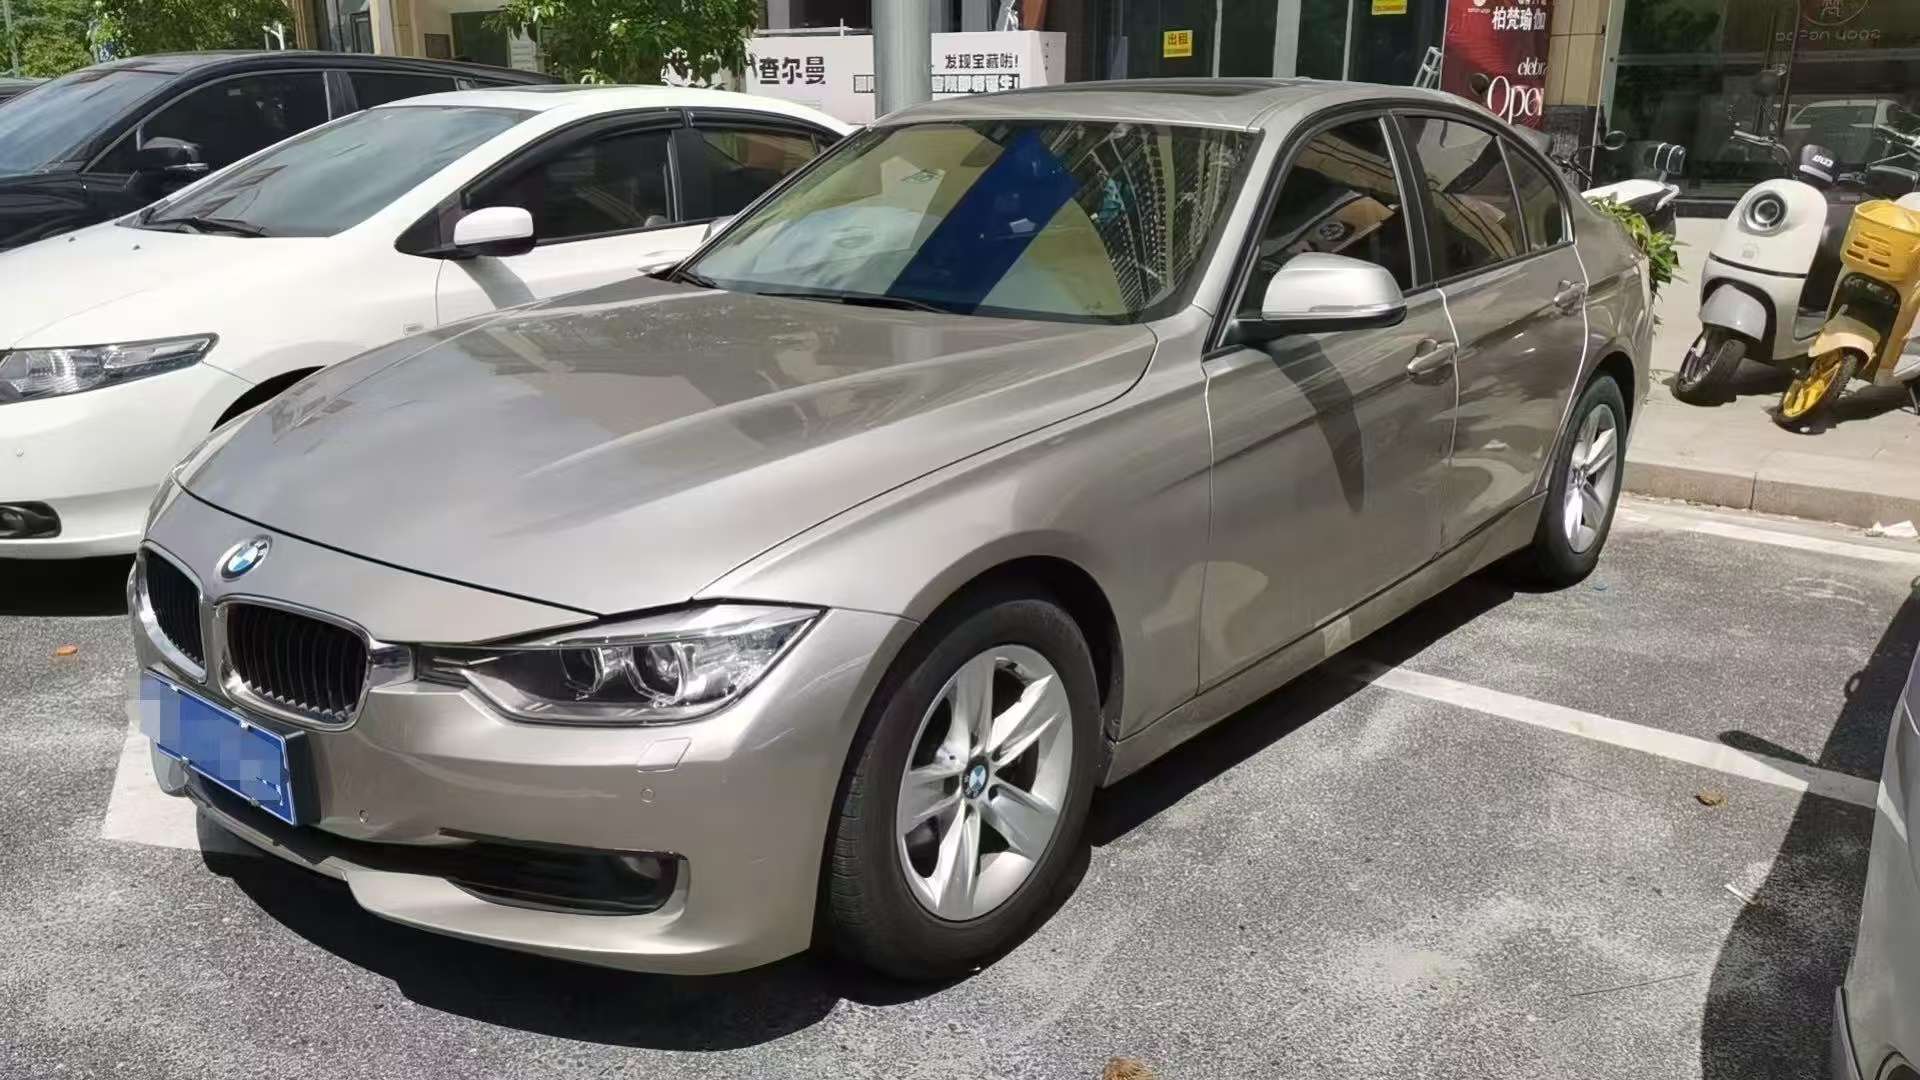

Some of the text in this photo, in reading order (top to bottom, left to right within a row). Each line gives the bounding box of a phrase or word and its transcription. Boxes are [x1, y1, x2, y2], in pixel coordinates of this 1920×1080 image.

[1492, 6, 1546, 30] 柏梵瑜伽
[1167, 32, 1188, 45] 出租
[750, 54, 826, 85] 查尔曼
